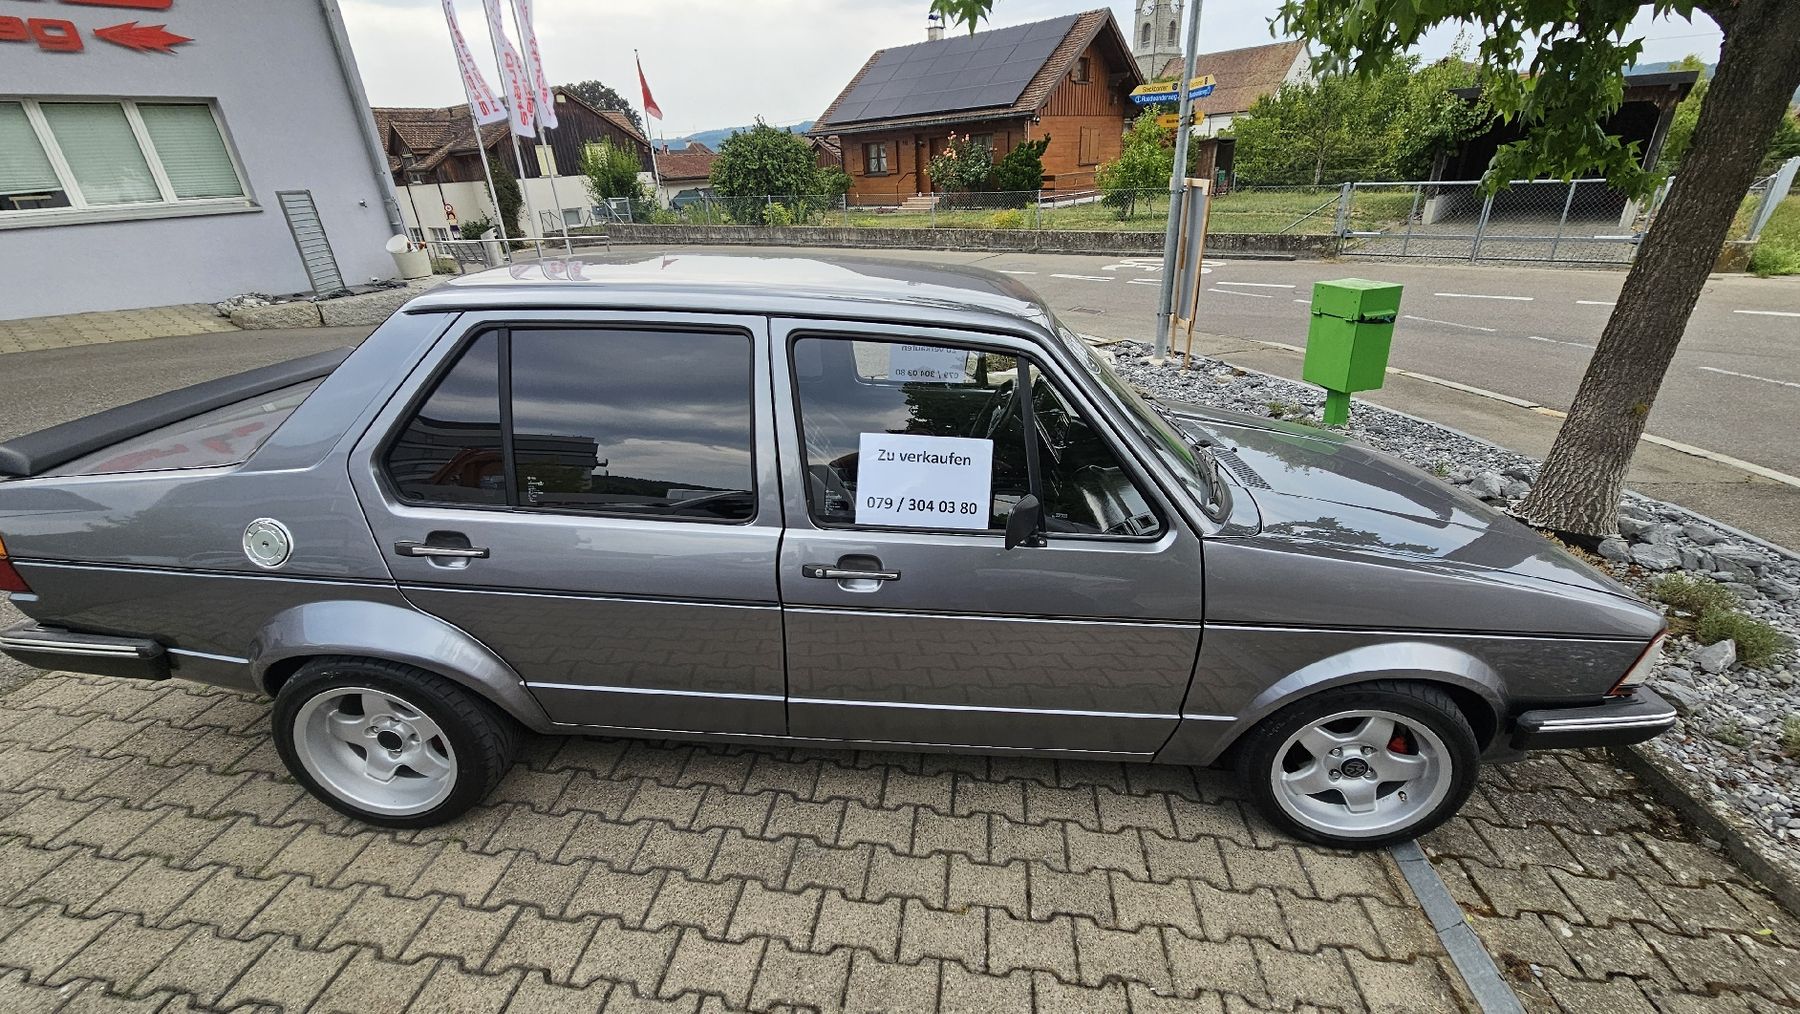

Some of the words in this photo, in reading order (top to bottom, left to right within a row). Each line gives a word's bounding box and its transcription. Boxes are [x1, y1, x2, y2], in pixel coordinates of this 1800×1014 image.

[877, 449, 895, 461] Zu
[899, 450, 971, 466] verkaufen
[867, 496, 893, 509] 079
[896, 497, 905, 512] /
[908, 498, 935, 512] 304
[939, 500, 955, 514] 03
[960, 502, 977, 515] 80
